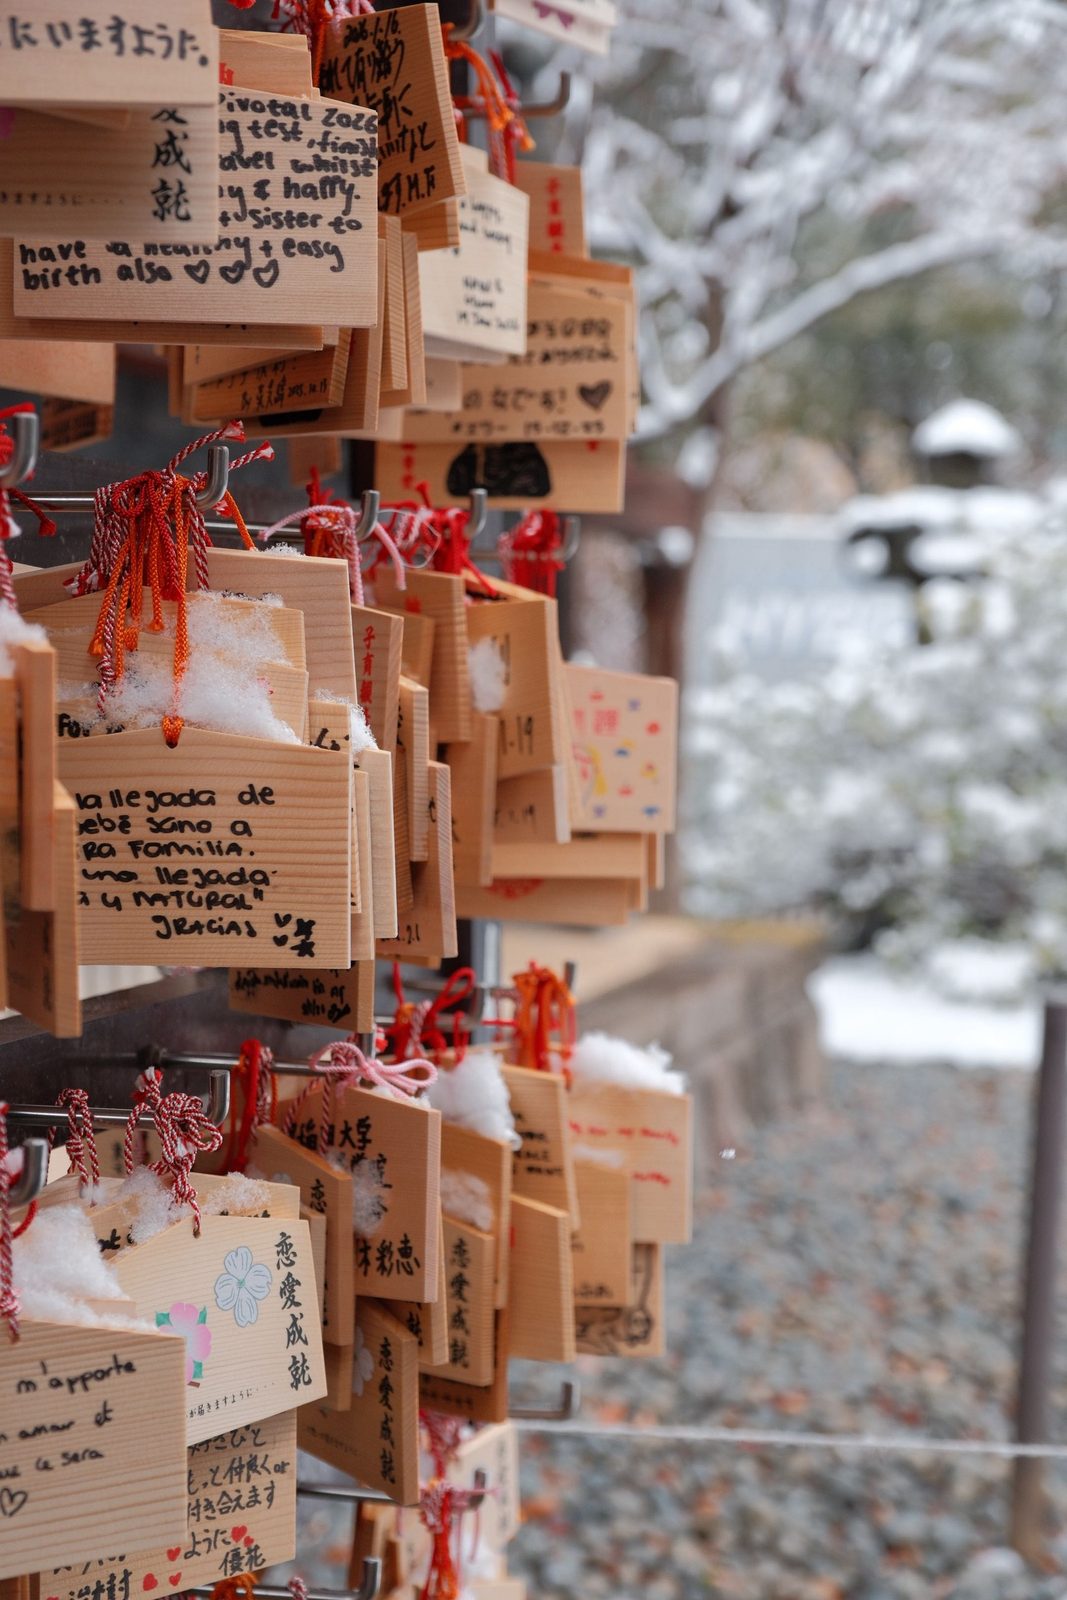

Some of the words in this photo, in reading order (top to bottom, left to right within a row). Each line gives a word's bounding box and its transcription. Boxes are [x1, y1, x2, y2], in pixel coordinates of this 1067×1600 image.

[247, 119, 303, 142] test
[321, 107, 377, 134] 2026
[219, 150, 275, 171] avel
[290, 153, 376, 177] whilst
[327, 216, 363, 235] to
[19, 240, 87, 265] have
[259, 240, 273, 258] +
[282, 237, 345, 273] easy
[23, 264, 101, 291] birth
[117, 260, 173, 283] also
[109, 789, 216, 813] llegada
[237, 784, 276, 806] de
[230, 820, 252, 838] a
[309, 1178, 328, 1214] 恋
[274, 1231, 313, 1391] 恋愛成就
[450, 1237, 471, 1369] 恋愛成就
[17, 1354, 137, 1395] m'apporte
[378, 1336, 396, 1485] 恋愛成就
[0, 1465, 21, 1480] ue
[61, 1448, 104, 1467] sera
[184, 1529, 231, 1560] ように
